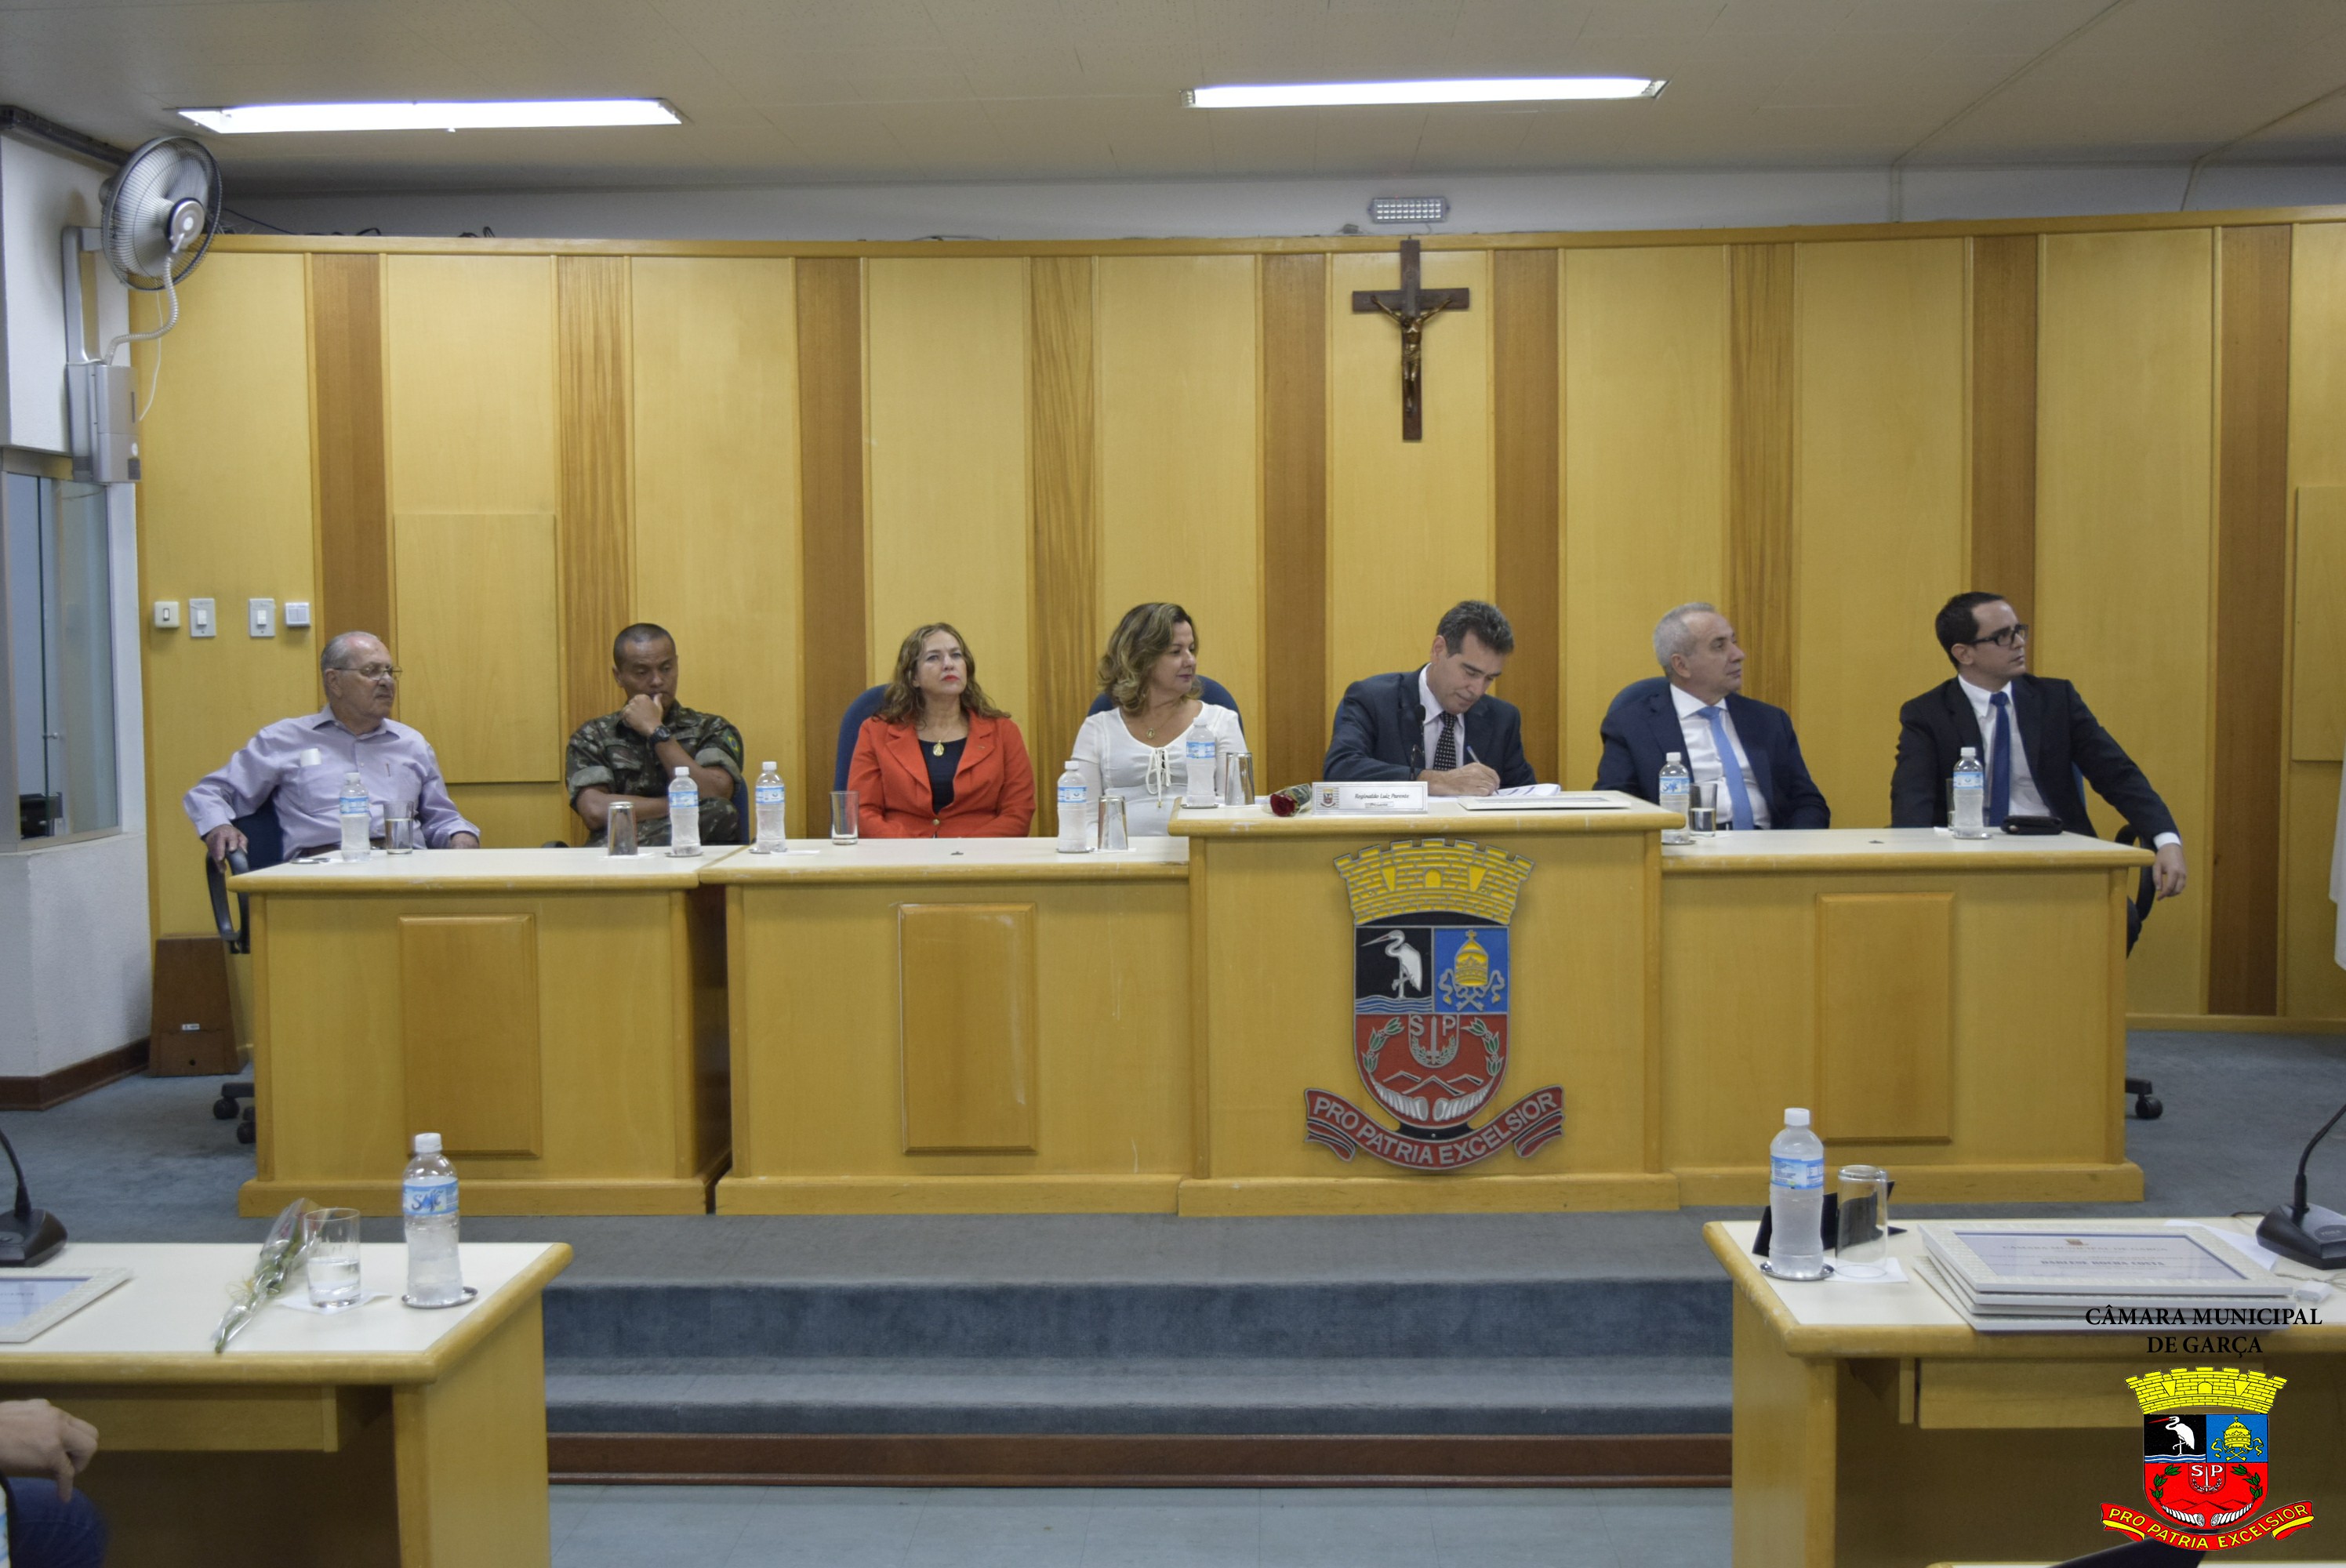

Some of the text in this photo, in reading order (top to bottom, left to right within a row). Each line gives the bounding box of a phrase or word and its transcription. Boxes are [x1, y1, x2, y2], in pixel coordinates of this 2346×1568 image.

[1313, 1093, 1557, 1164] PRO PATRIA EXCELSIOR
